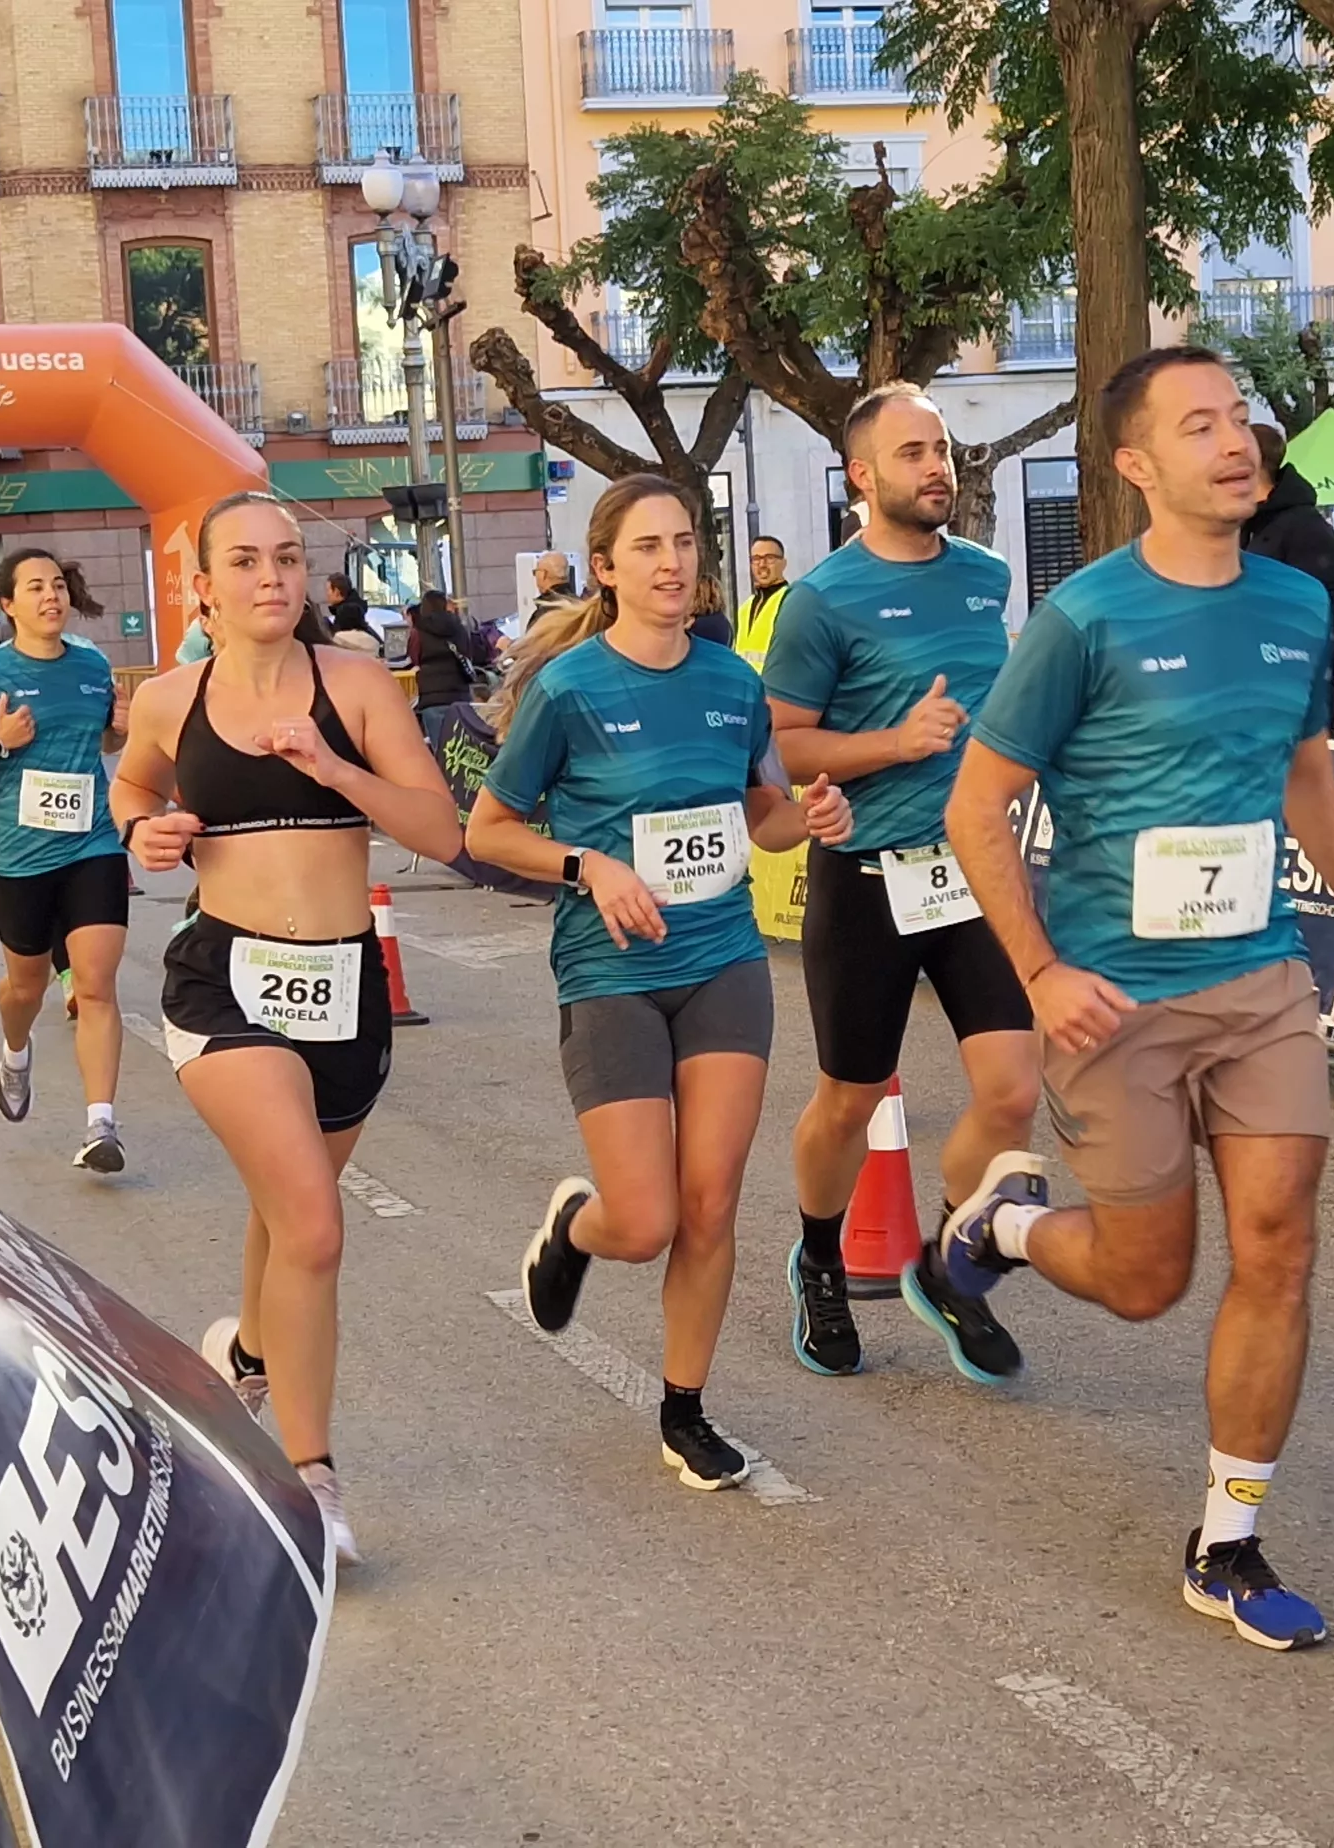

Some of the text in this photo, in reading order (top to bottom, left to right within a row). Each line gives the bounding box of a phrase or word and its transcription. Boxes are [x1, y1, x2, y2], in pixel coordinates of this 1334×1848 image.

[39, 791, 81, 810] 266
[664, 832, 725, 865] 265
[666, 862, 726, 881] SANDRA
[930, 865, 949, 889] 8
[1199, 865, 1222, 895] 7
[673, 880, 695, 894] 8K
[921, 887, 969, 907] JAVIER
[1178, 899, 1237, 916] JORGE
[280, 953, 334, 963] CARRERA
[259, 973, 331, 1006] 268
[261, 1005, 328, 1021] ANGELA
